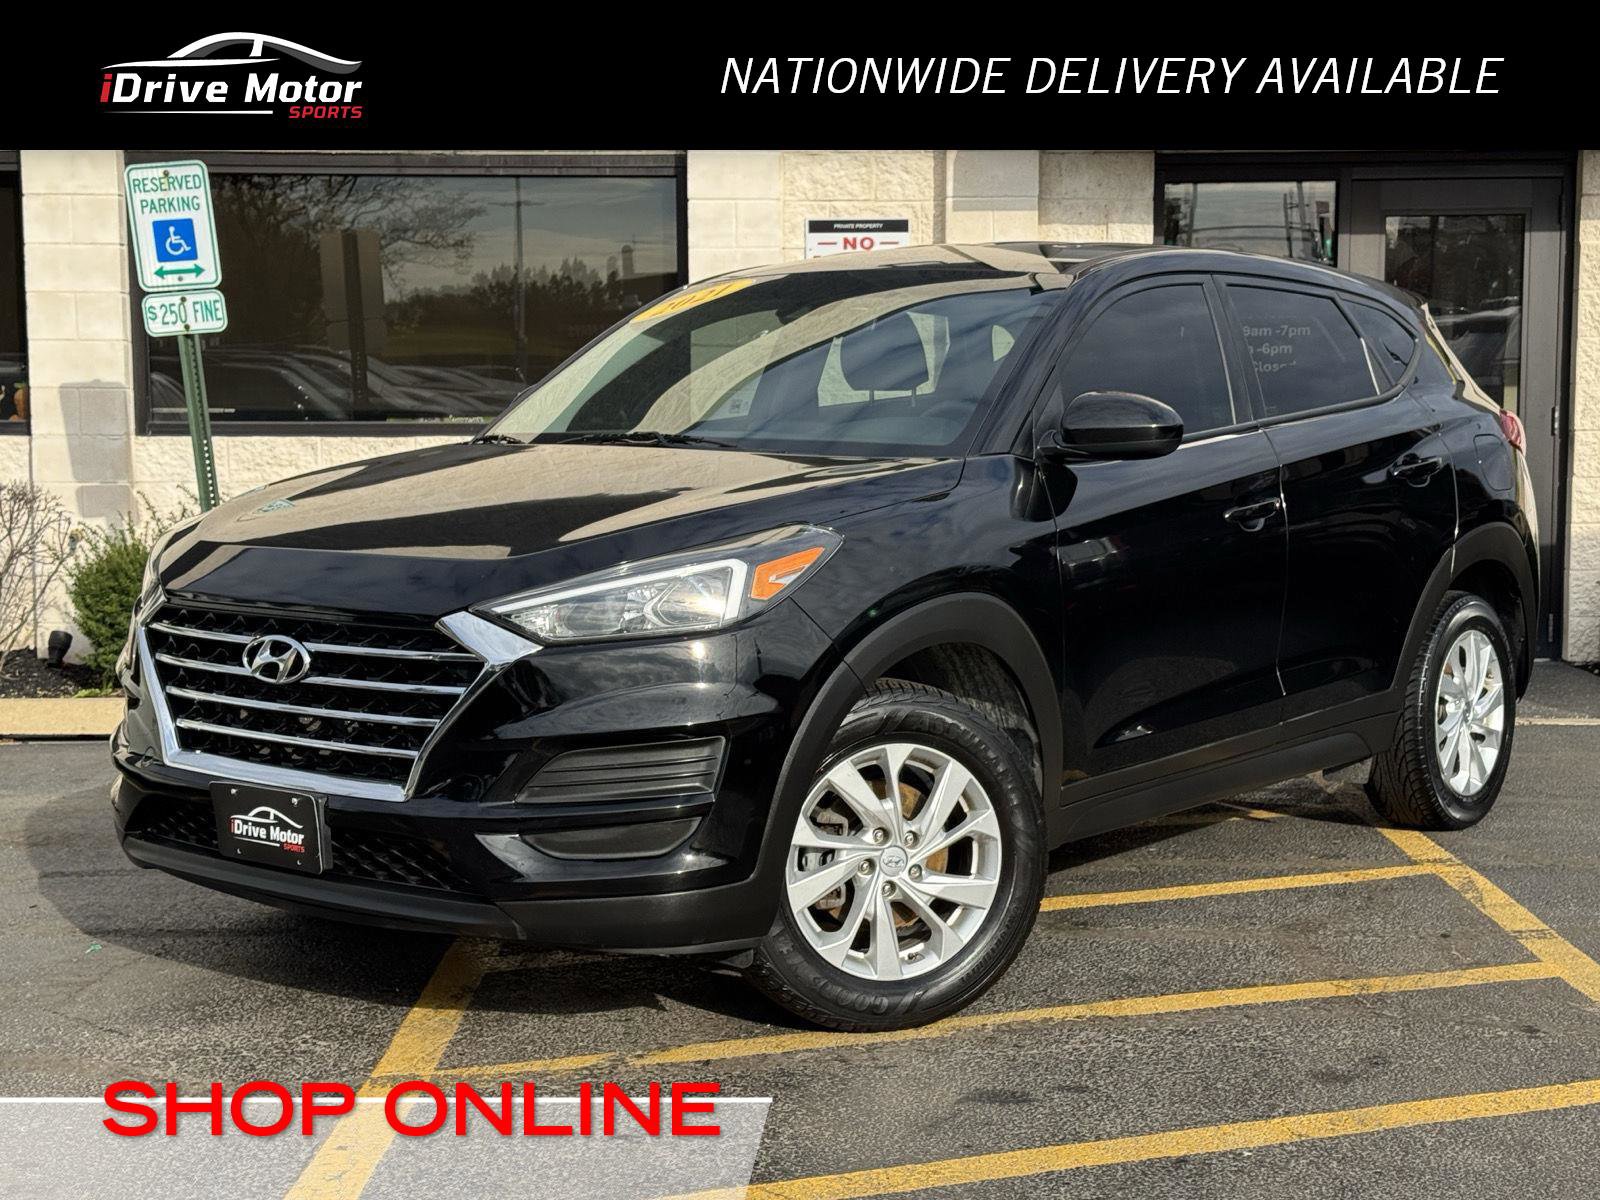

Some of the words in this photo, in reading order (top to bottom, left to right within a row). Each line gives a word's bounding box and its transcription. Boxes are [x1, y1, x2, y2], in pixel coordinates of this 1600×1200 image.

[132, 174, 201, 194] RESERVED
[140, 196, 201, 215] PARKING
[843, 236, 875, 250] NO
[147, 302, 188, 326] $250
[193, 300, 223, 324] FINE
[230, 819, 267, 839] iDrive
[269, 825, 305, 845] Motor
[284, 844, 305, 853] SPORTS
